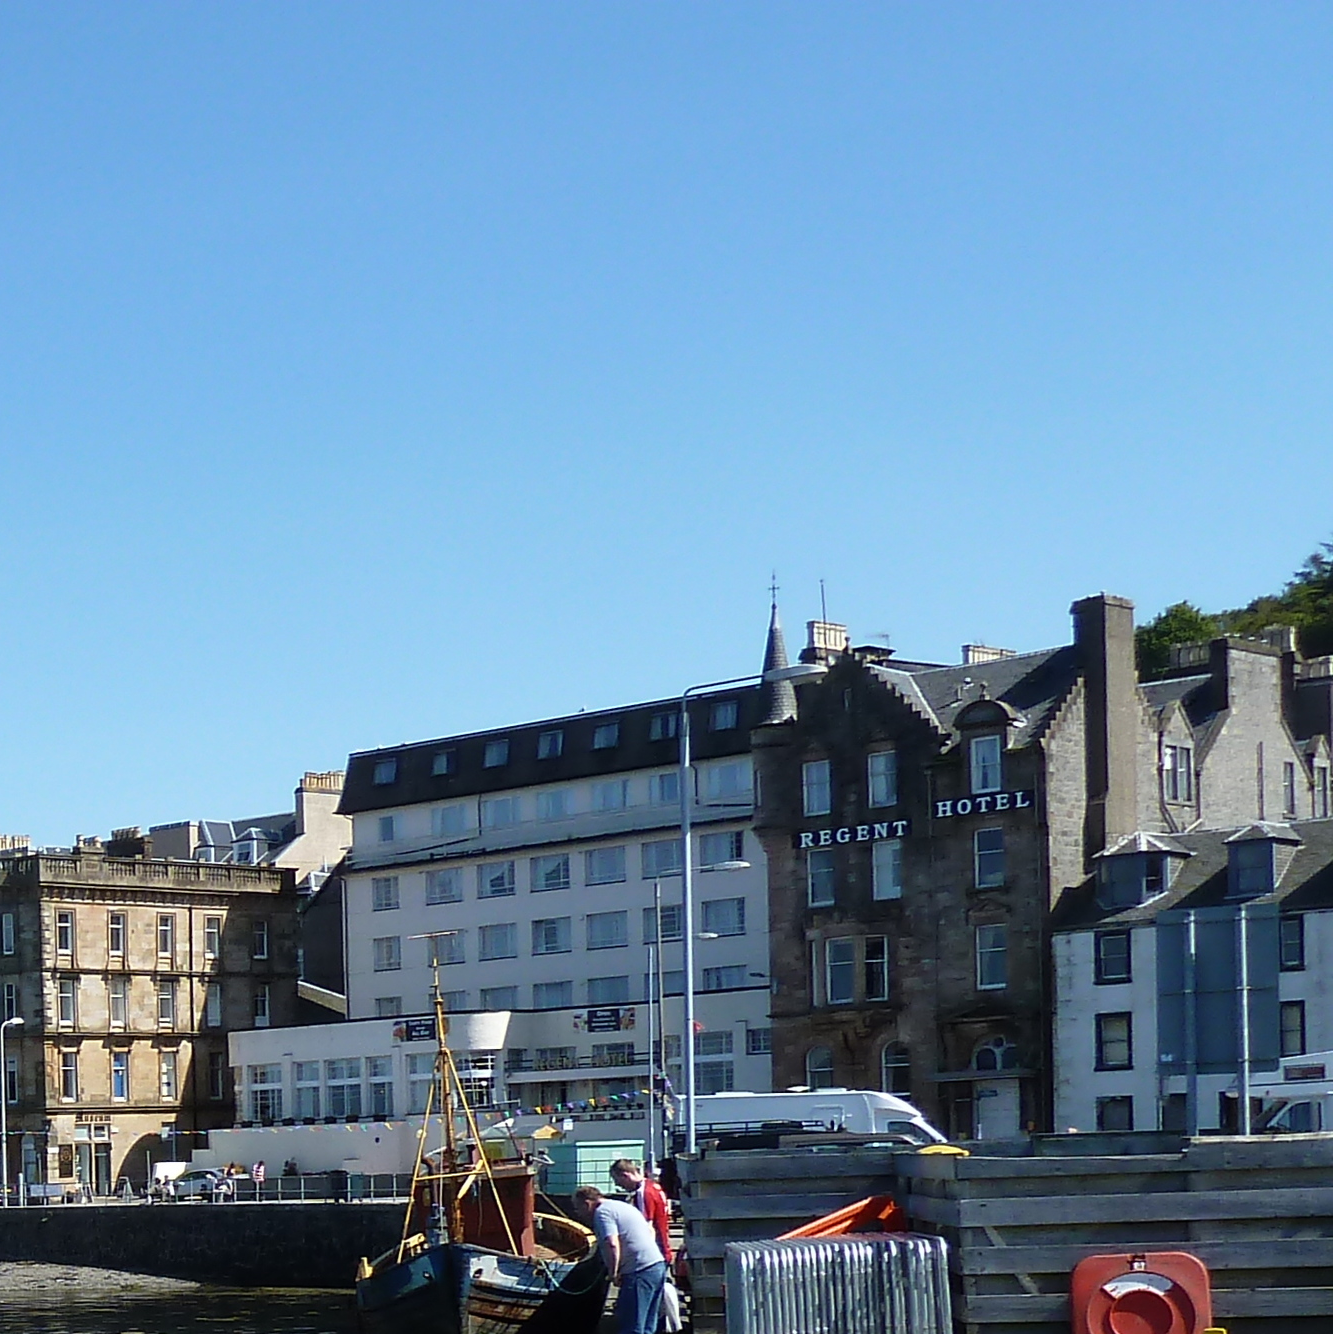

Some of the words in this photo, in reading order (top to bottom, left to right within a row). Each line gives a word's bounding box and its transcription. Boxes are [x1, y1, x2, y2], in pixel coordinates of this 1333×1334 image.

[799, 820, 908, 848] REGENT
[935, 791, 1030, 817] HOTEL
[591, 1052, 632, 1067] HOTEL
